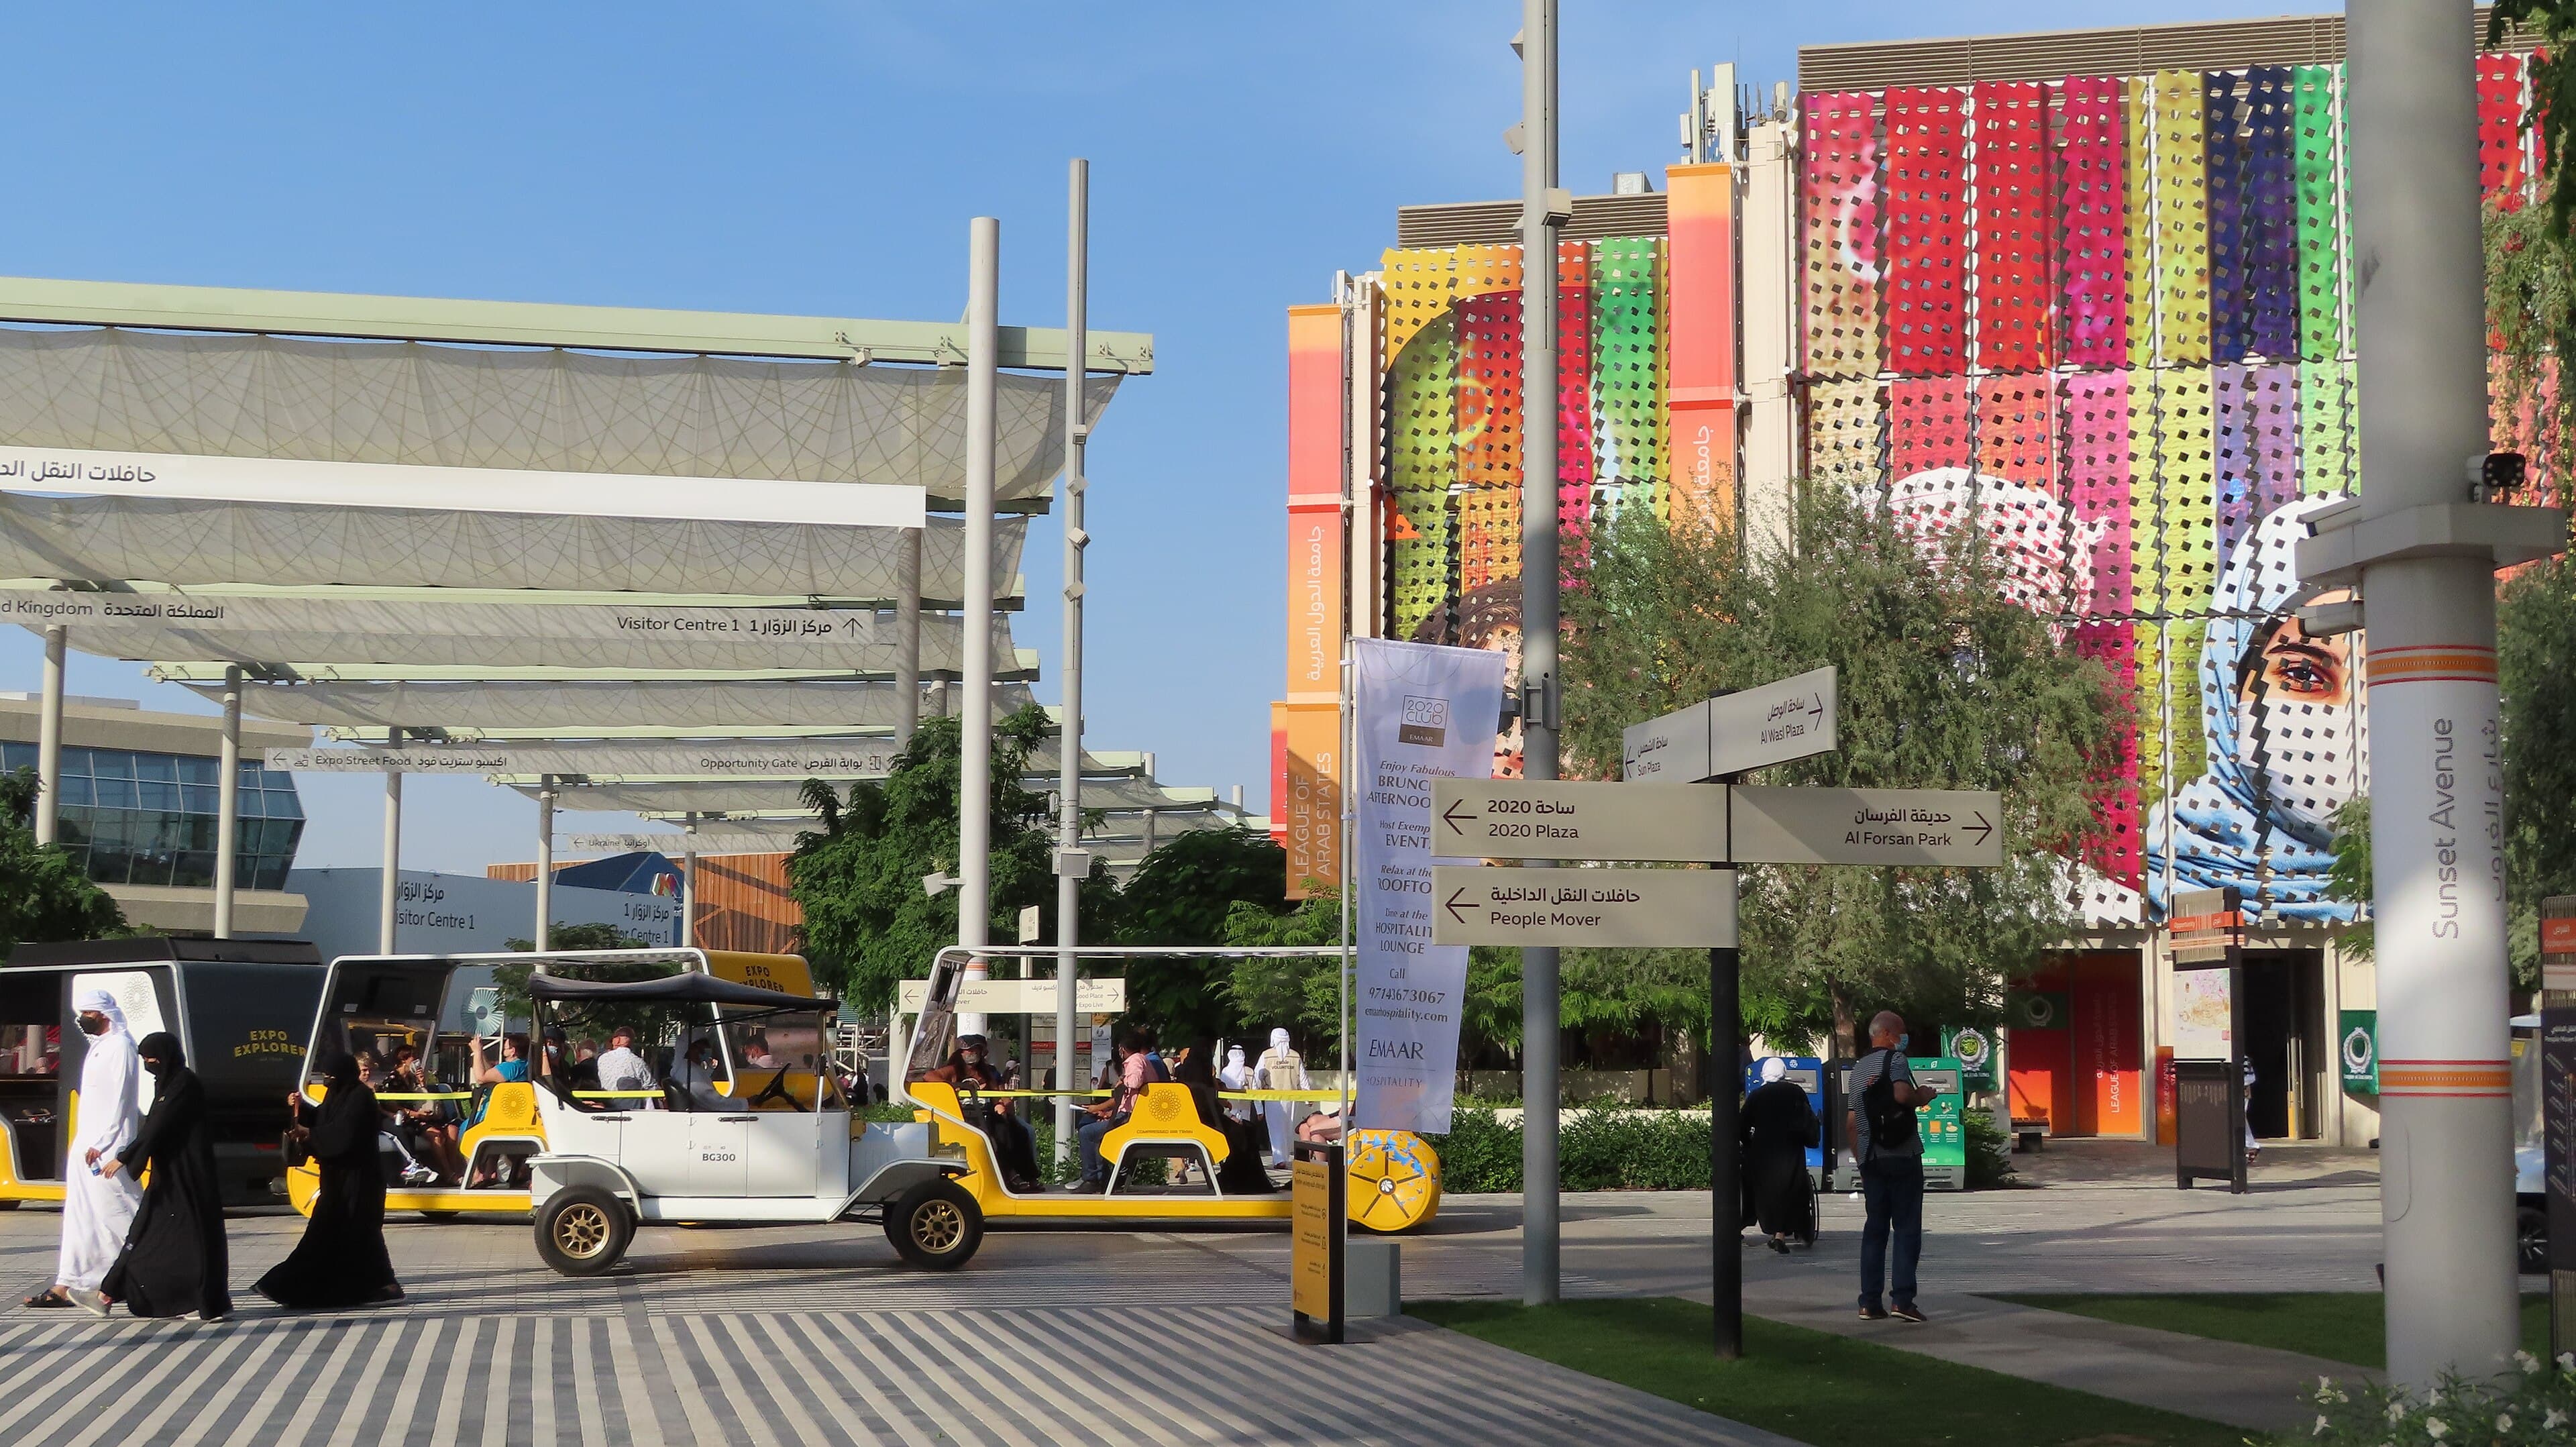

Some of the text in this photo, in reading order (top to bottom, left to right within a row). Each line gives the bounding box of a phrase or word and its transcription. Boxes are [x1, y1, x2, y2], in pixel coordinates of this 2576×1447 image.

[32, 462, 82, 482] النقل
[89, 465, 156, 482] حافلات
[17, 601, 93, 617] Kingdom
[1307, 525, 1326, 681] جامعة الدول العربية
[104, 603, 224, 619] المملكة المتحدة
[616, 617, 739, 631] Visitor Centre 1
[750, 619, 758, 632] 1
[800, 620, 832, 635] مركز
[1407, 700, 1444, 714] 2020
[1768, 697, 1805, 722] ساحة الوصل
[1409, 734, 1433, 742] EMAAR
[1760, 723, 1805, 745] Al Wasl Plaza
[316, 756, 411, 767] Expo Street Food
[418, 757, 436, 768] فود
[439, 757, 473, 767] ستريت
[700, 758, 798, 770] Opportunity Gate
[804, 758, 863, 770] بوابة الفرص
[1380, 761, 1456, 777] Enjoy Fabulous
[1638, 761, 1661, 776] Sun Plaza
[1379, 775, 1431, 791] BRUNC
[1366, 791, 1431, 808] AFTERNOO
[1488, 800, 1574, 814] ساحة 2020
[1316, 752, 1332, 876] ARAB STATES
[1855, 808, 1951, 826] حديقة الفرسان
[1295, 775, 1309, 877] LEAGUE OF
[1379, 820, 1431, 835] Host Exemp
[1489, 824, 1579, 839] 2020 Plaza
[2428, 718, 2459, 939] Sunset Avenue
[588, 839, 620, 847] Ukraine
[1386, 834, 1431, 849] EVENT
[1845, 831, 1952, 846] Al Forsan Park
[1381, 865, 1403, 875] Relax
[422, 883, 444, 903] مركز
[1377, 877, 1432, 894] ROOFTO
[1491, 887, 1640, 905] حافلات النقل الداخلية
[624, 903, 629, 916] 1
[652, 905, 669, 922] مركز
[1399, 910, 1409, 918] at
[1411, 909, 1428, 920] the
[396, 908, 475, 929] isitor Centre 1
[1491, 911, 1601, 928] People Mover
[631, 928, 661, 943] Centre
[663, 930, 669, 943] 1
[1375, 922, 1432, 938] HOSPITALIT
[1381, 940, 1425, 954] LOUNGE
[746, 966, 770, 977] EXPO
[1390, 968, 1405, 979] Call
[739, 979, 784, 992] PLORER
[250, 1030, 287, 1041] EXPO
[234, 1042, 307, 1057] EXPLORER
[1368, 1039, 1424, 1060] EMAAR
[2110, 1073, 2120, 1113] LEAGUE
[702, 1153, 736, 1162] BG300
